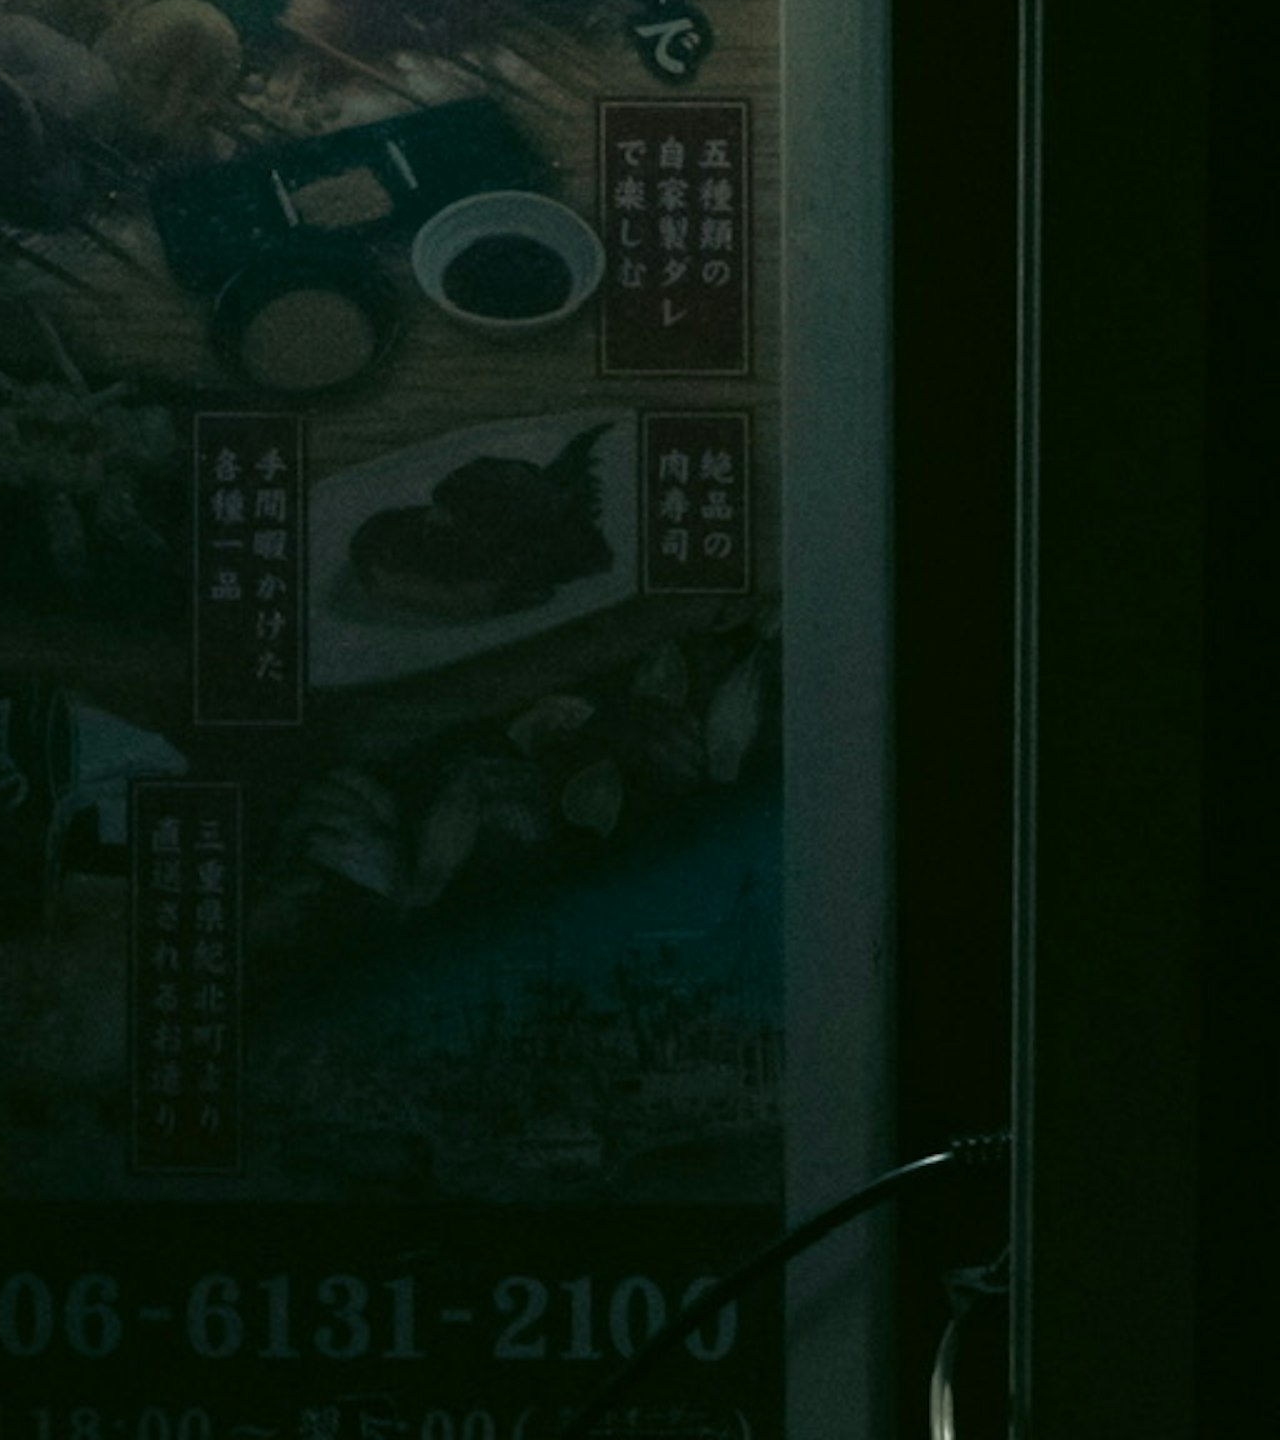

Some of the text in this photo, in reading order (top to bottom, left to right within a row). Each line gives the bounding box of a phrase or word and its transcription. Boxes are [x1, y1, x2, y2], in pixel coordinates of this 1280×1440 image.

[614, 139, 648, 289] で楽しむ
[656, 136, 691, 329] 自家製ダレ
[698, 139, 734, 287] 五種類の
[252, 447, 288, 682] 手間暇かけた
[659, 448, 690, 562] 肉寿司
[700, 448, 734, 560] 絶品の
